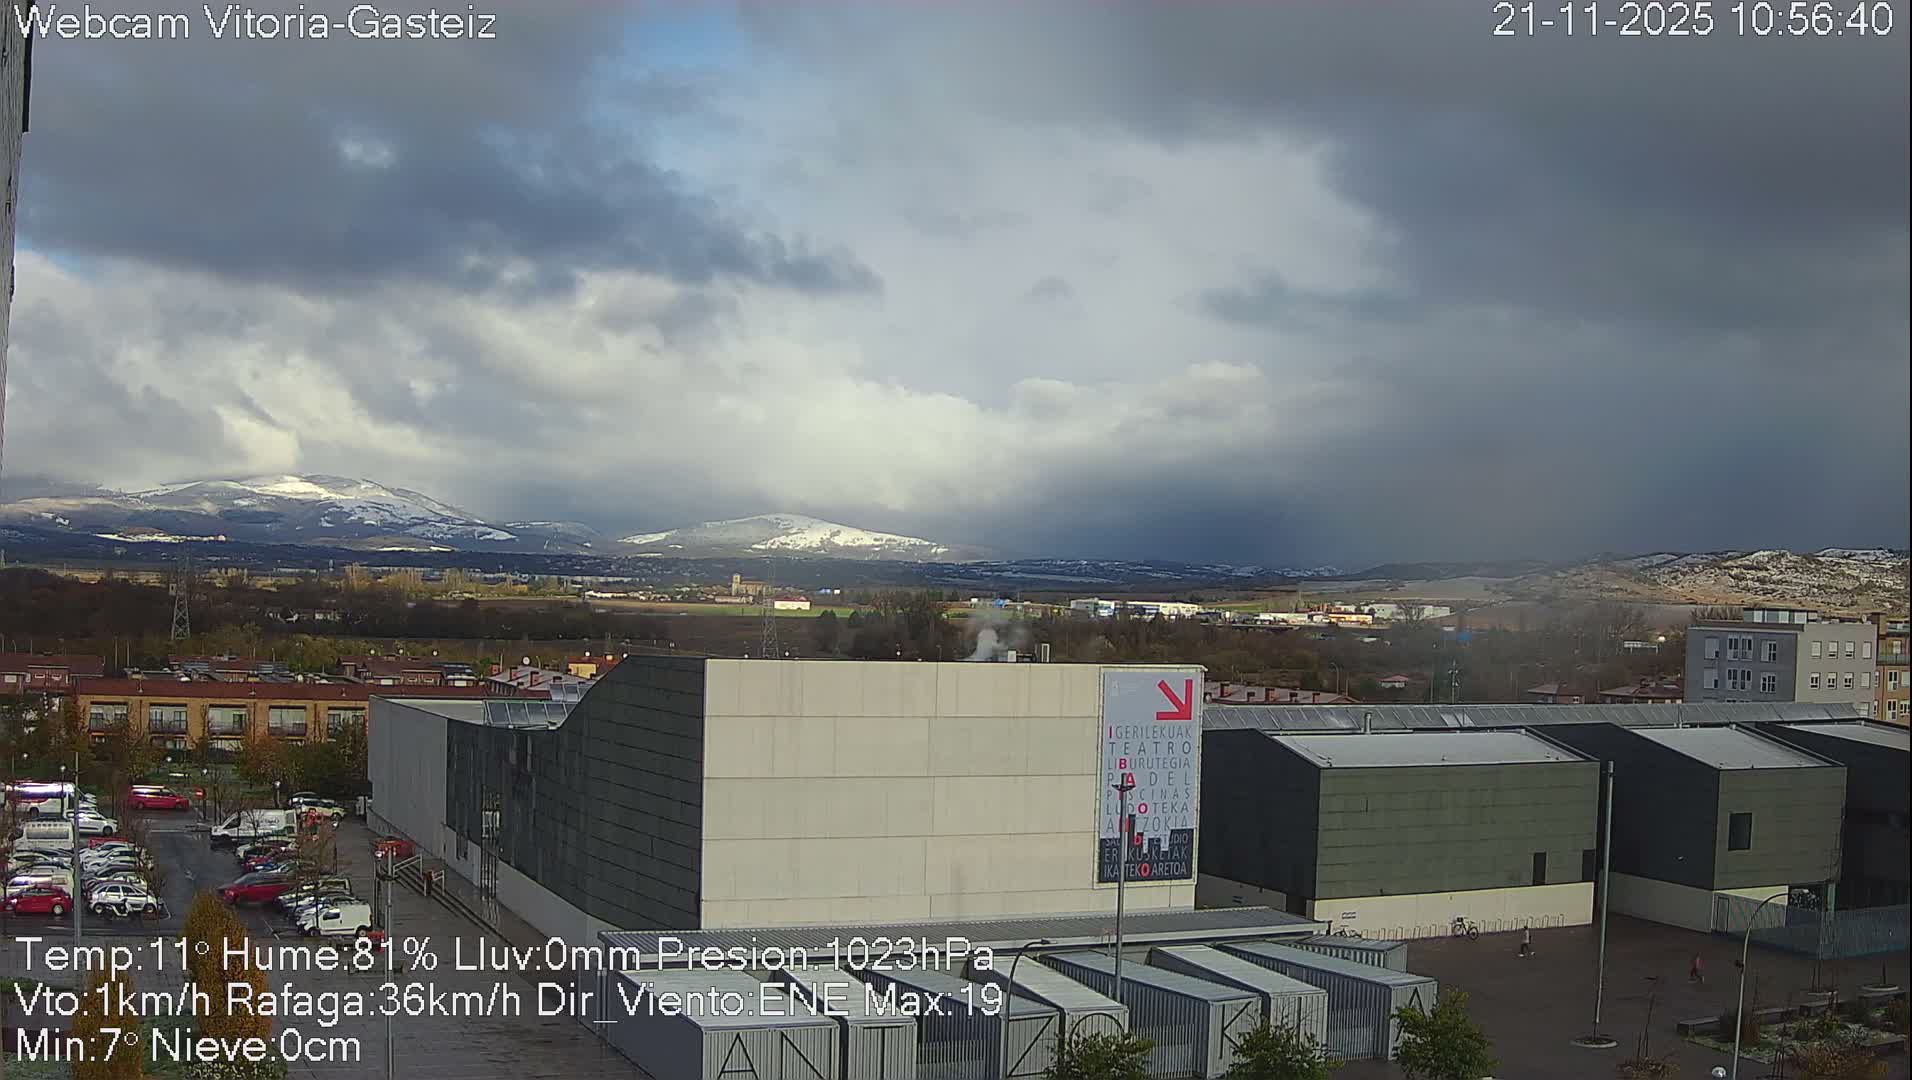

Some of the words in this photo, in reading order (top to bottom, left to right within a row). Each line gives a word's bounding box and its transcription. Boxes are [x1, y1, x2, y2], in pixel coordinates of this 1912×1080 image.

[1109, 725, 1192, 739] IGERILEKUAK
[1108, 741, 1191, 755] TEATRO
[1107, 757, 1190, 770] LIBURUTEGIA
[1106, 788, 1190, 801] PISCINAS
[1106, 802, 1188, 815] LUDOTEKA
[1105, 845, 1187, 862] ERKUSKETAK
[1104, 863, 1150, 878] IKATEKO
[1151, 861, 1187, 876] ARETOA
